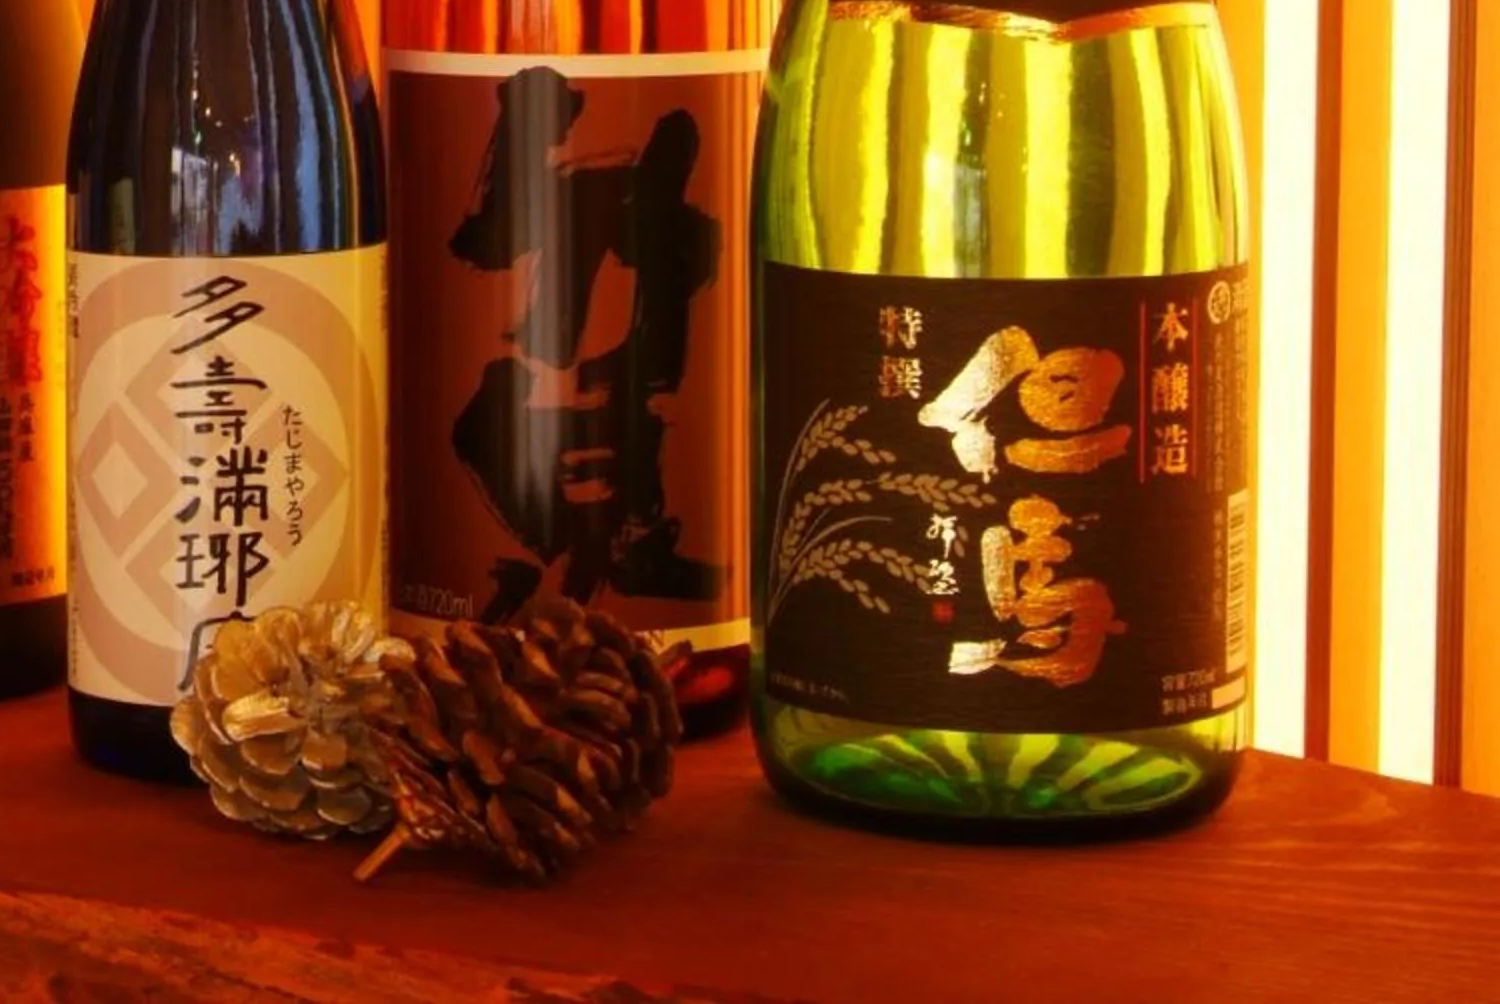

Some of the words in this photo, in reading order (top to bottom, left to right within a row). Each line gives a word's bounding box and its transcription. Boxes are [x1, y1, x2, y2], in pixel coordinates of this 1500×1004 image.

[281, 403, 304, 547] たじまやろう
[1151, 302, 1190, 476] 本醸造
[917, 324, 1132, 688] 但馬
